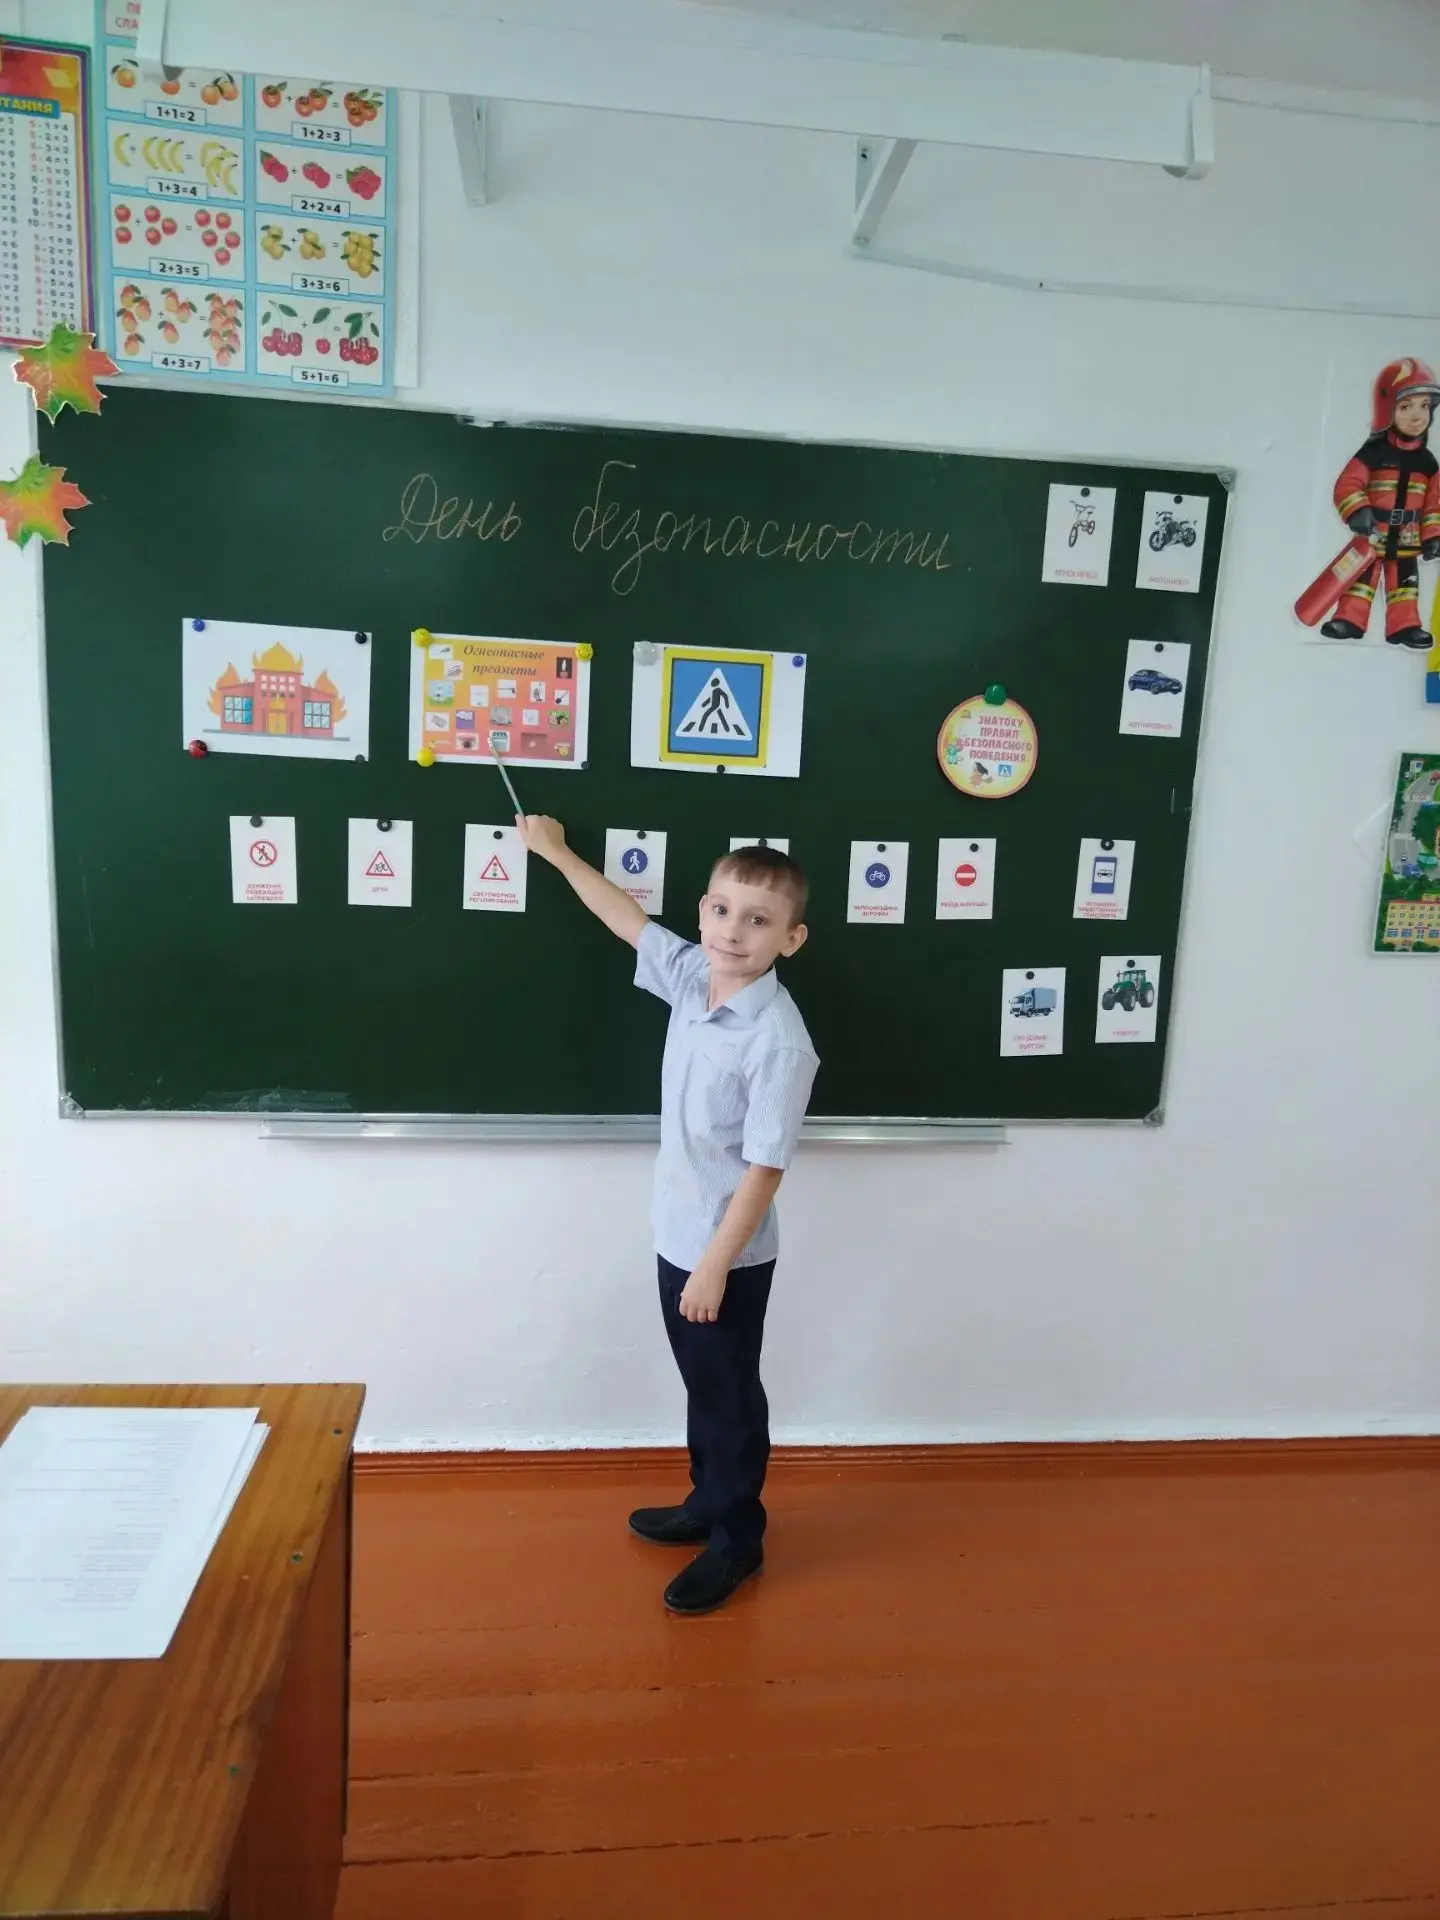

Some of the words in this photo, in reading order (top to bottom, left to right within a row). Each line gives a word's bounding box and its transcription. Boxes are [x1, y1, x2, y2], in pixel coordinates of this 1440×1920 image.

[157, 105, 196, 122] 1+1=2
[302, 127, 341, 142] 1+2=3
[157, 182, 198, 197] 1+3=4
[301, 200, 341, 214] 2+2=4
[159, 263, 200, 277] 2+3=5
[301, 278, 341, 292] 3+3=6
[161, 357, 200, 370] 4+3=7
[301, 370, 339, 384] 5+1=6
[382, 473, 522, 543] День
[572, 460, 952, 596] безопасности
[463, 644, 545, 661] Огнеопасные
[472, 664, 537, 678] предметы
[978, 715, 1023, 728] ЗНАТОКУ
[980, 727, 1019, 739] ПРАВИЛ
[964, 738, 1032, 752] БЕЗОПАСНОГО
[969, 749, 1026, 763] ПОВЕДЕНИЯ
